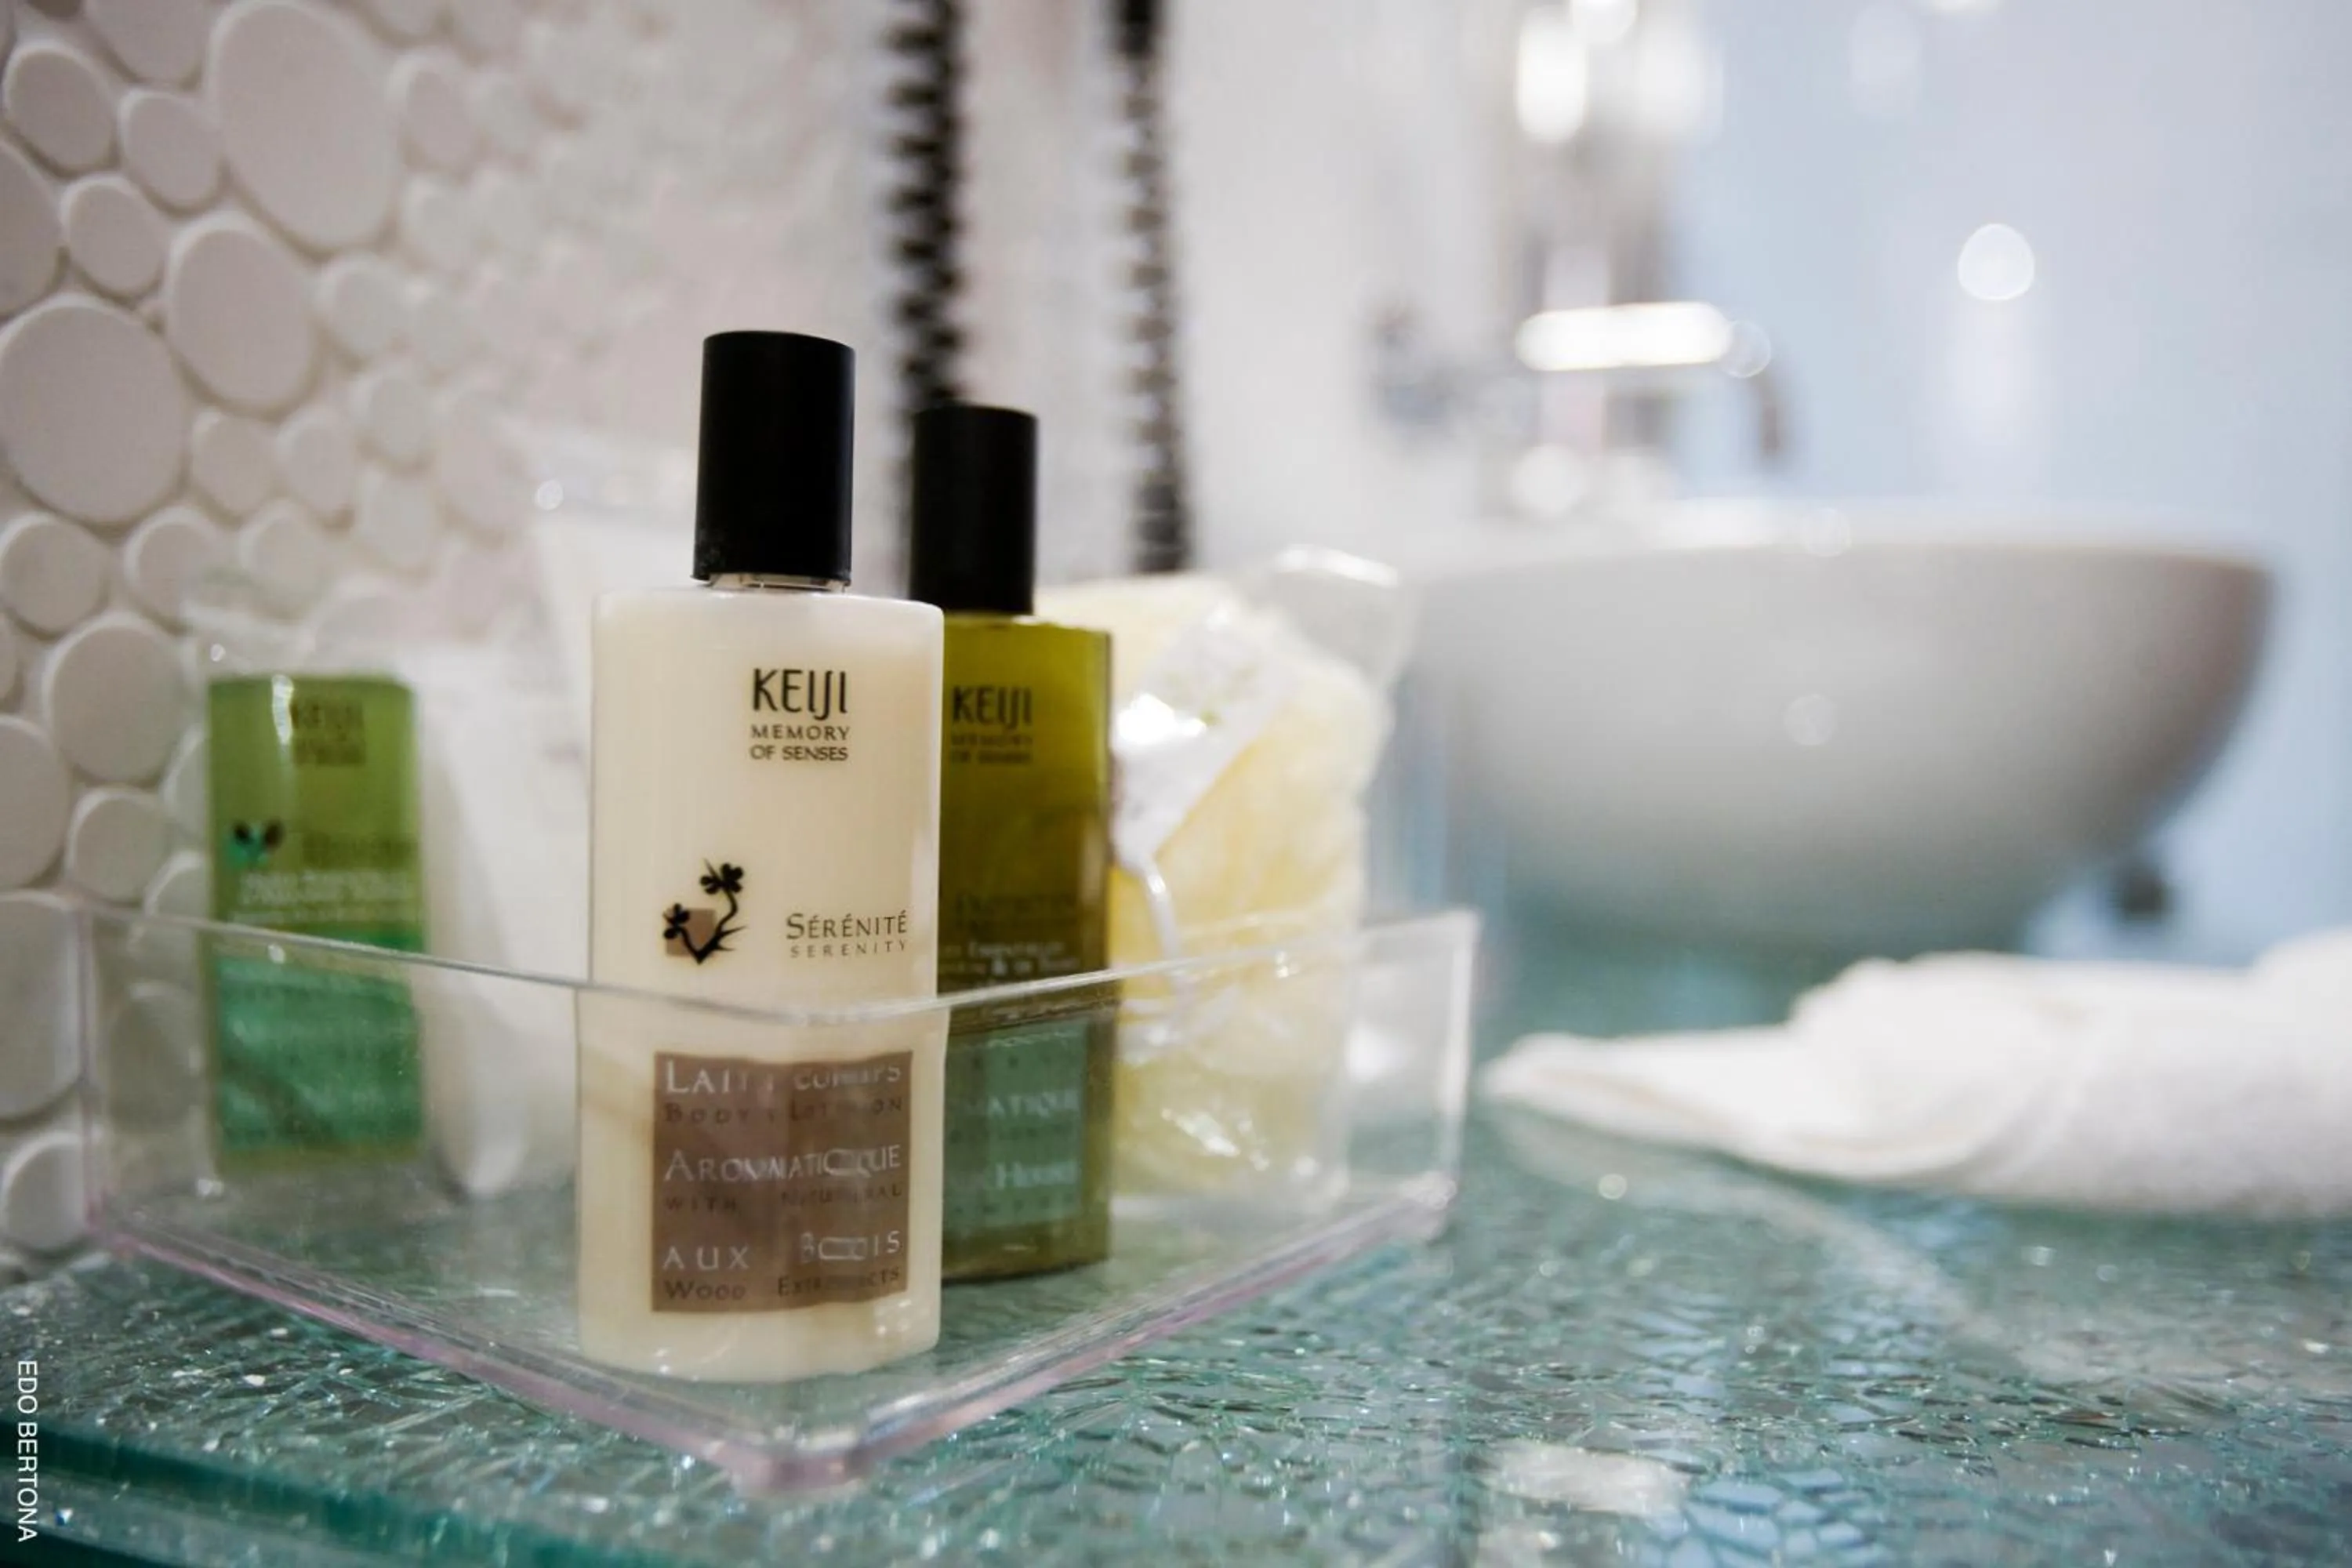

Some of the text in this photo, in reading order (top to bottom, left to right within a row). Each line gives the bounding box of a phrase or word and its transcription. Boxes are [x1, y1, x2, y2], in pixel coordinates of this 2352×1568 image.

[753, 668, 848, 720] KEIJI
[953, 686, 1033, 730] KEIJI
[750, 724, 850, 740] MEMORY
[750, 744, 848, 760] OF SENSES
[786, 909, 907, 939] SÉRÉNITÉ
[790, 939, 907, 958] SERENITY
[663, 1246, 749, 1270] AUX
[664, 1279, 746, 1300] WOOD
